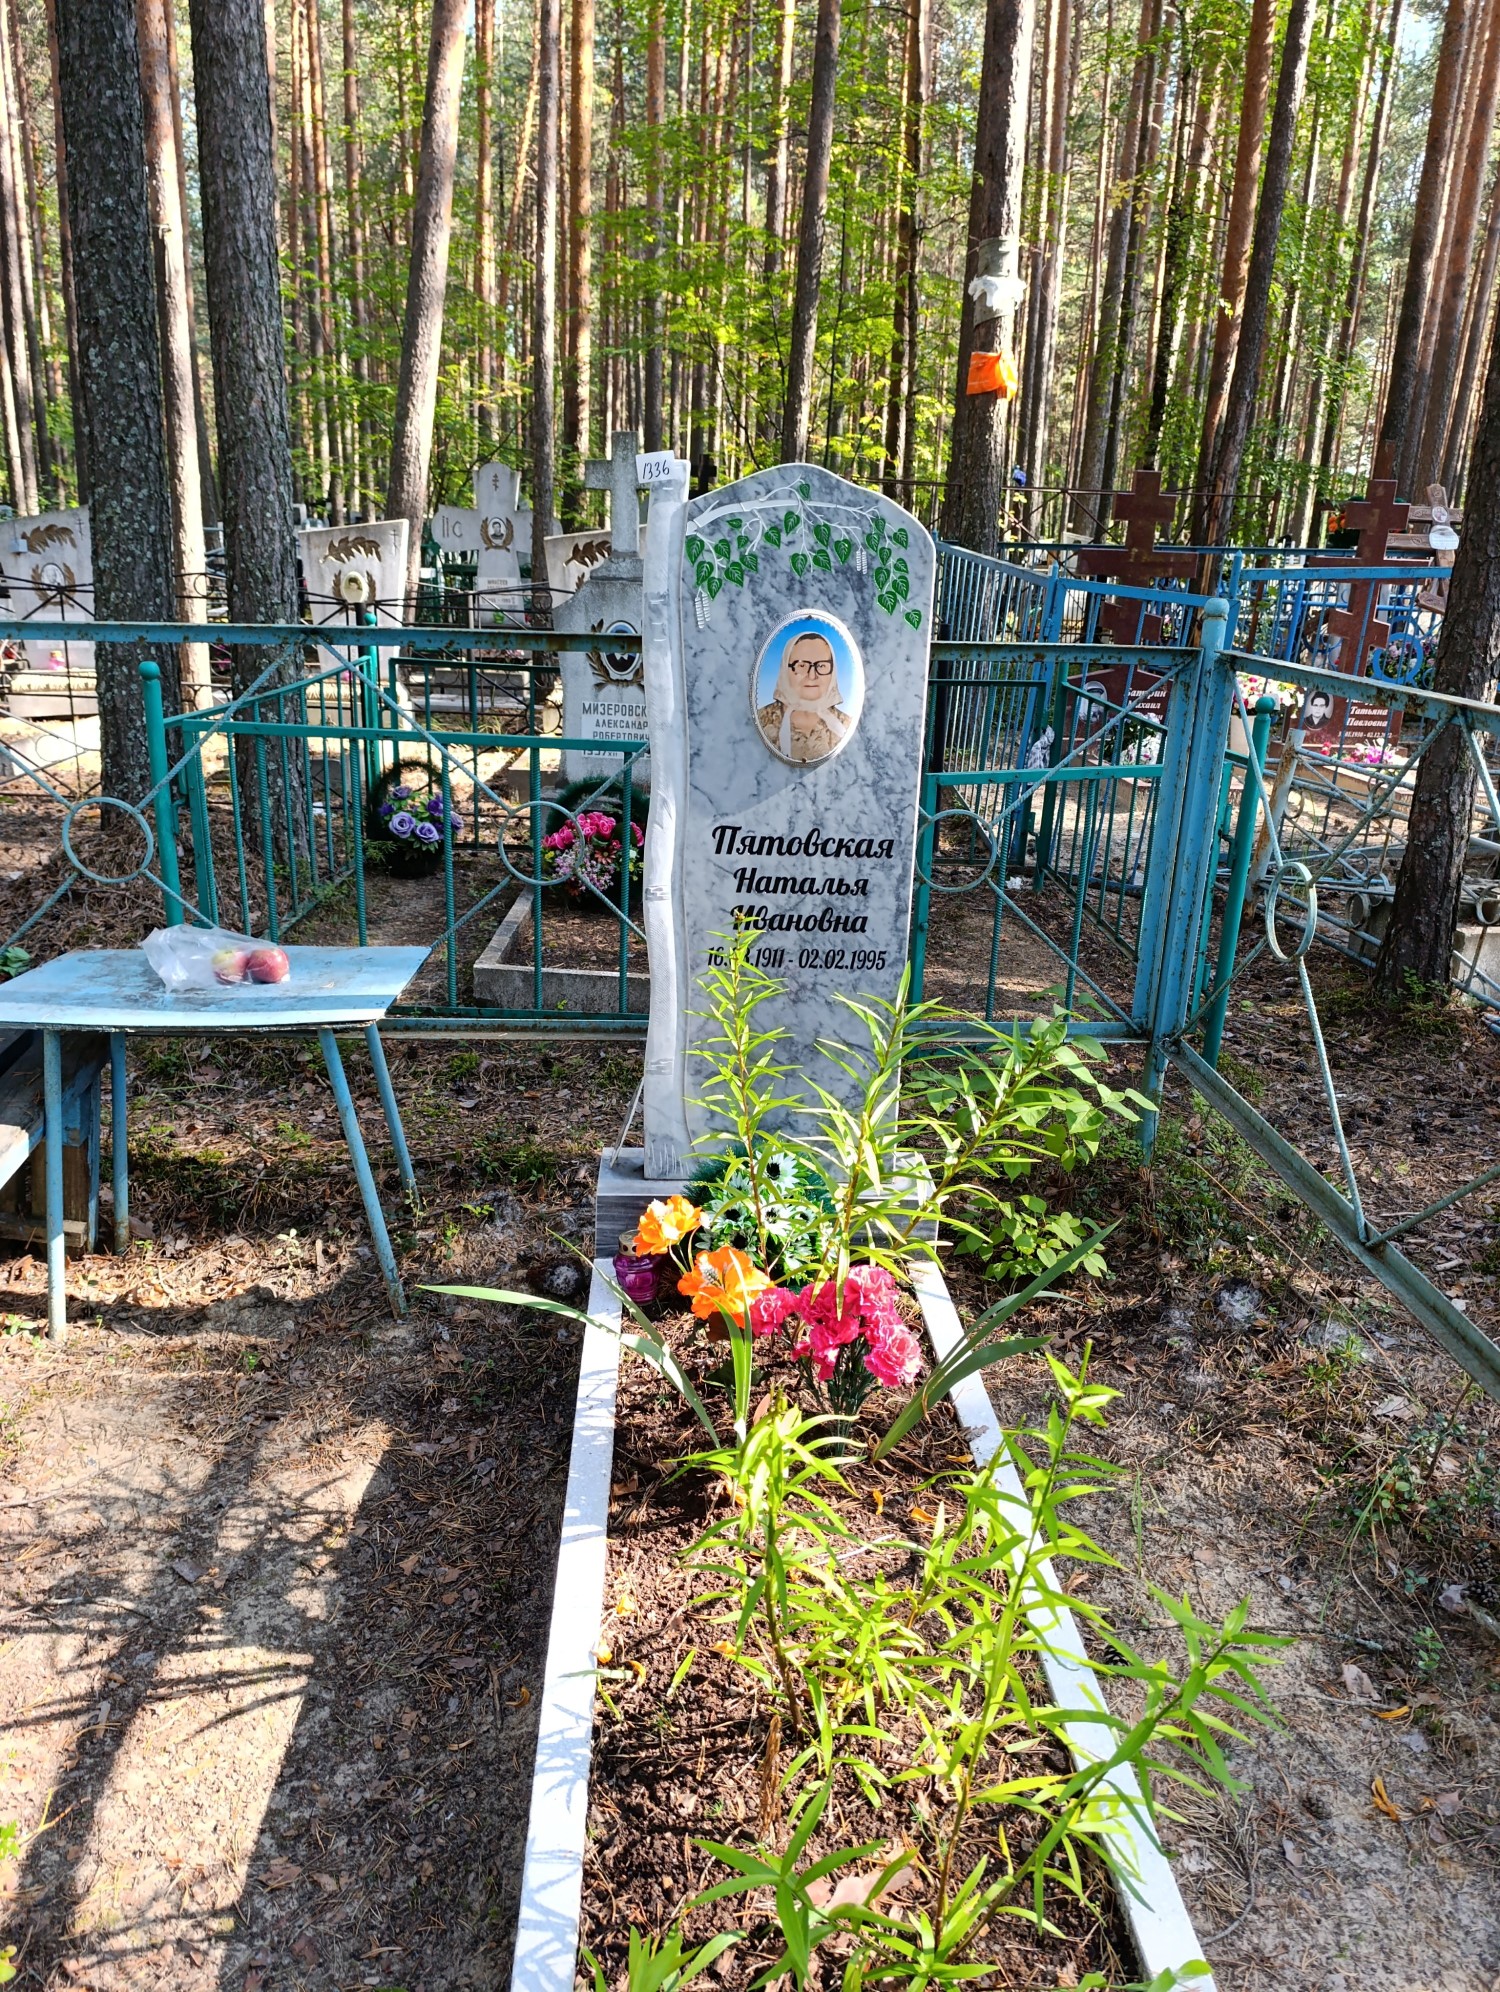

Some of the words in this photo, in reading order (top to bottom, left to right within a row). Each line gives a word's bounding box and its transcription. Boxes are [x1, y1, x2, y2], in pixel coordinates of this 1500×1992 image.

[642, 459, 670, 480] 1336
[1350, 706, 1388, 716] Татьяна
[595, 718, 649, 730] АЛЕКСАНДР
[1346, 717, 1388, 727] Павловна
[711, 825, 895, 859] Пятовская
[733, 867, 869, 896] Наталья
[730, 904, 868, 934] Ивановна
[799, 949, 887, 970] 02.02.1995
